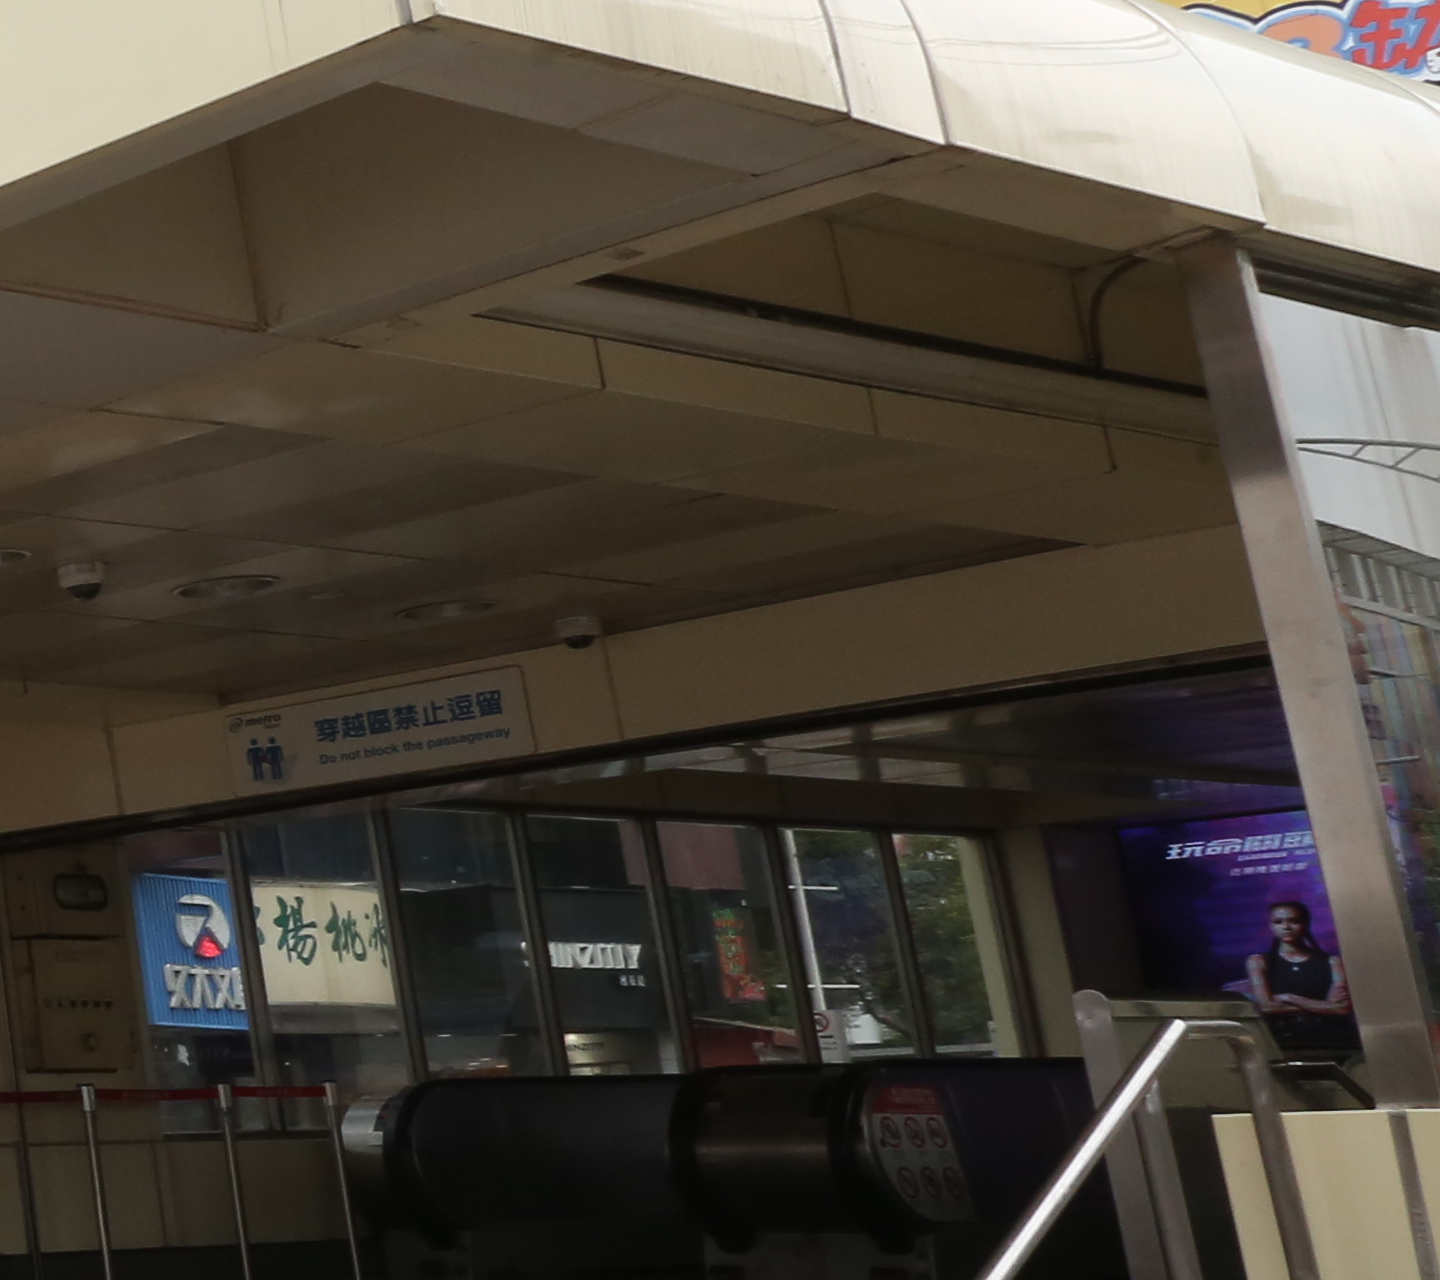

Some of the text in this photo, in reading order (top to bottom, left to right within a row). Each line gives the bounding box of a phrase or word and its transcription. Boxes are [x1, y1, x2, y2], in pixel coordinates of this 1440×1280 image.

[243, 714, 282, 726] metro
[314, 689, 504, 744] 穿越區禁止逗留
[319, 728, 511, 765] Do not block the passageway
